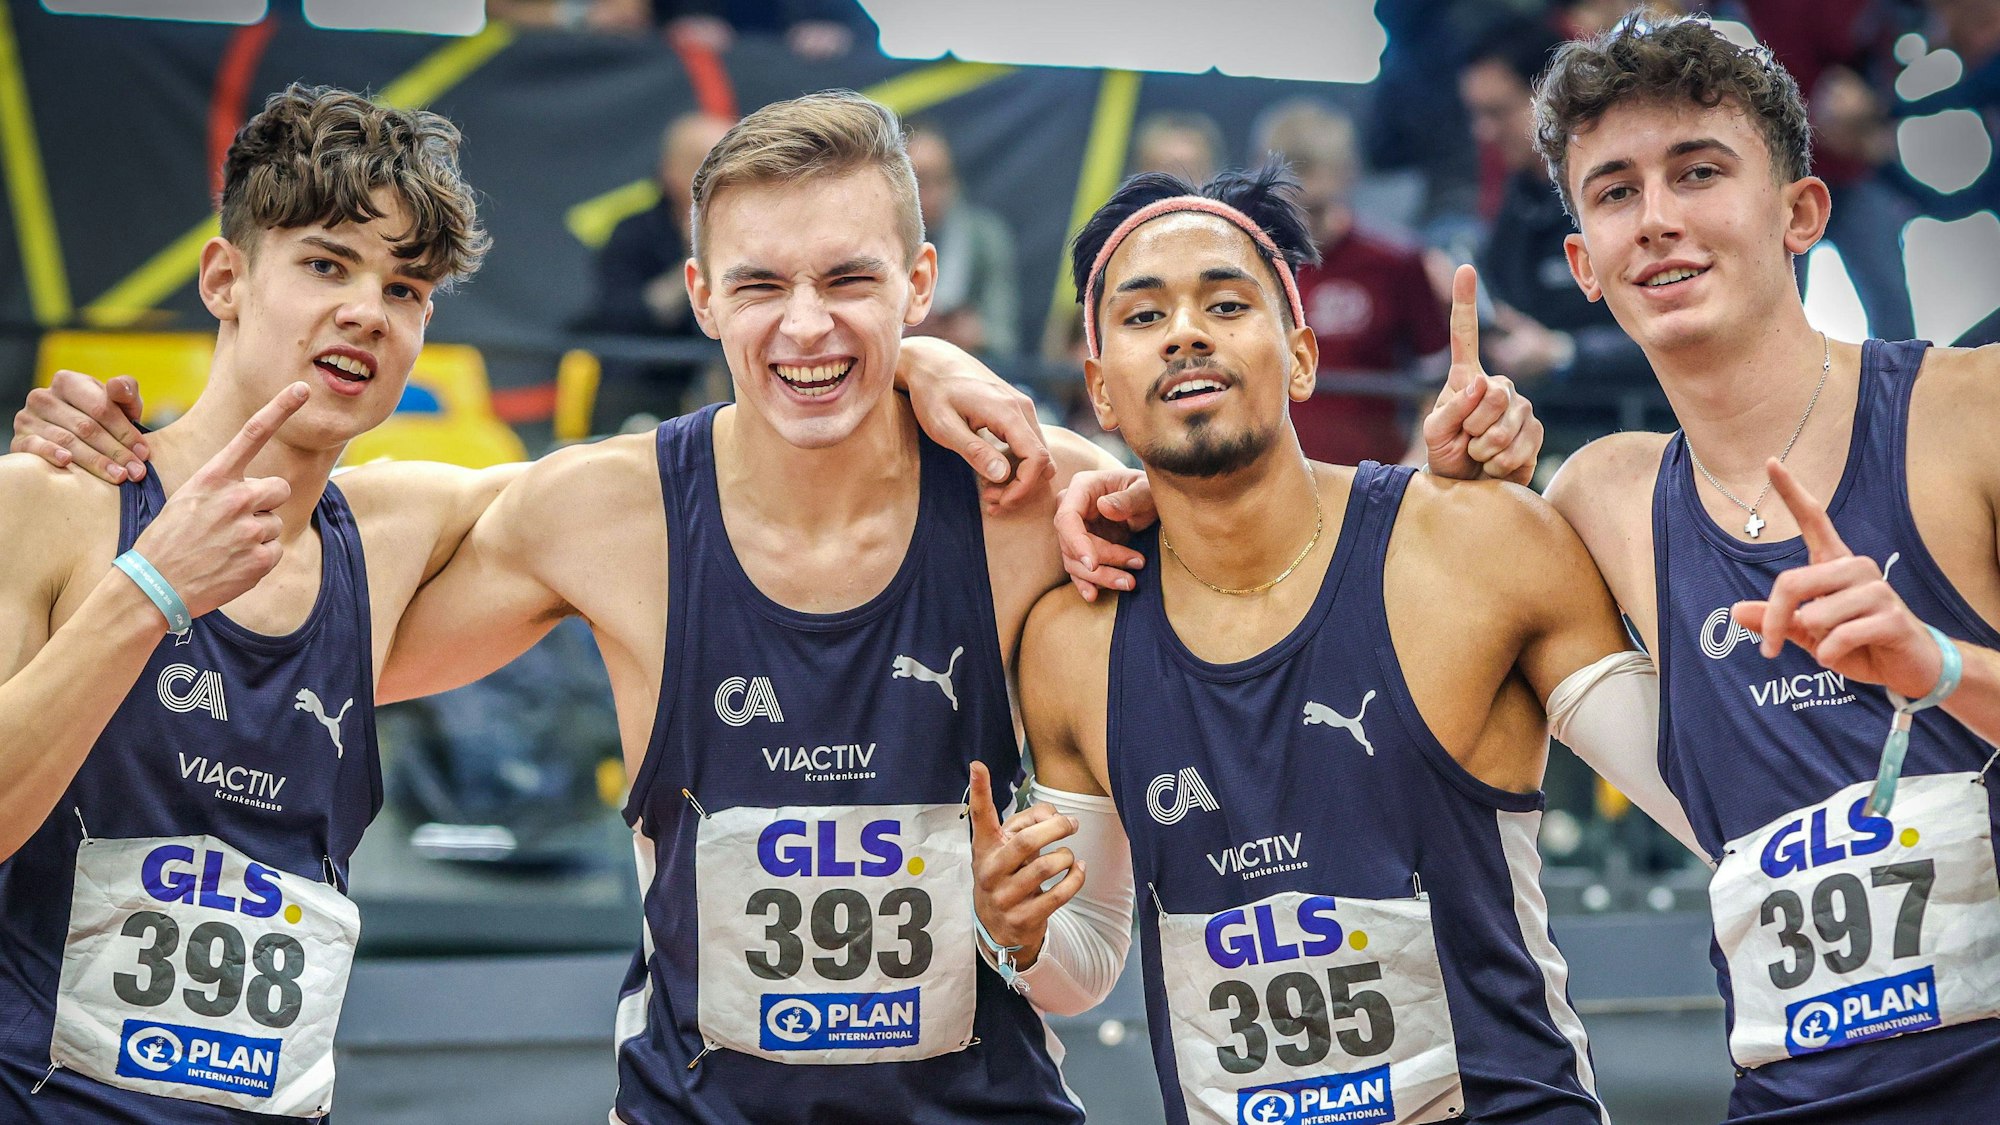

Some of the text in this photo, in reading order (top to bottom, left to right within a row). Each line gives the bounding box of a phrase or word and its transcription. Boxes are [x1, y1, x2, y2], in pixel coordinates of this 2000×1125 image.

[157, 662, 228, 721] CA
[714, 676, 785, 726] CA
[1749, 670, 1847, 709] VIACTIV
[178, 751, 287, 800] VIACTIV
[761, 743, 878, 772] VIACTIV
[804, 771, 877, 783] Krankenkasse
[214, 788, 283, 812] Krankenkasse
[1146, 766, 1220, 825] CA
[1206, 832, 1302, 876] VIACTIV
[745, 887, 933, 980] 393
[1760, 859, 1934, 990] 397
[113, 910, 305, 1028] 398
[828, 1002, 914, 1028] PLAN
[1209, 961, 1396, 1074] 395
[1843, 981, 1929, 1025] PLAN
[828, 1030, 913, 1042] INTERNATIONAL
[1845, 1011, 1932, 1040] INTERNATIONAL
[188, 1038, 274, 1077] PLAN
[187, 1066, 269, 1090] INTERNATIONAL
[1301, 1077, 1386, 1111] PLAN
[1301, 1109, 1387, 1125] INTERNATIONAL
